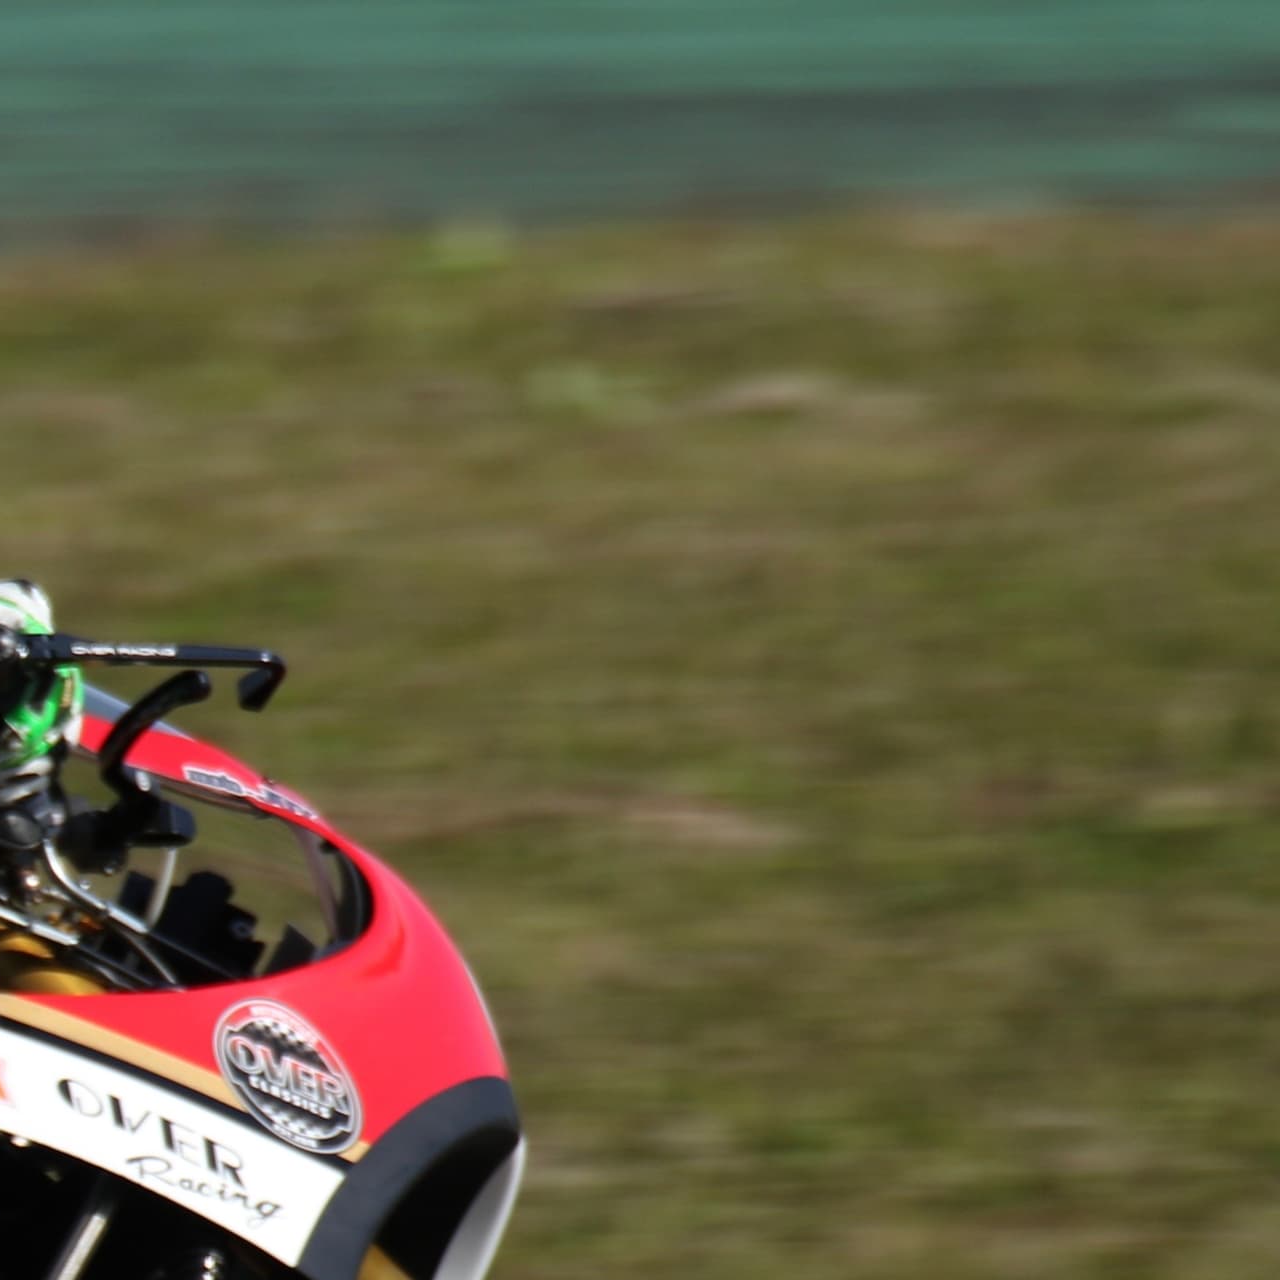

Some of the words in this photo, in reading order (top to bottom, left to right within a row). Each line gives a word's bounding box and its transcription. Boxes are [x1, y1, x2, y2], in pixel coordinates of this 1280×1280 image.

[228, 1036, 351, 1117] OVER
[55, 1077, 246, 1188] OVER
[125, 1155, 282, 1229] Racing
